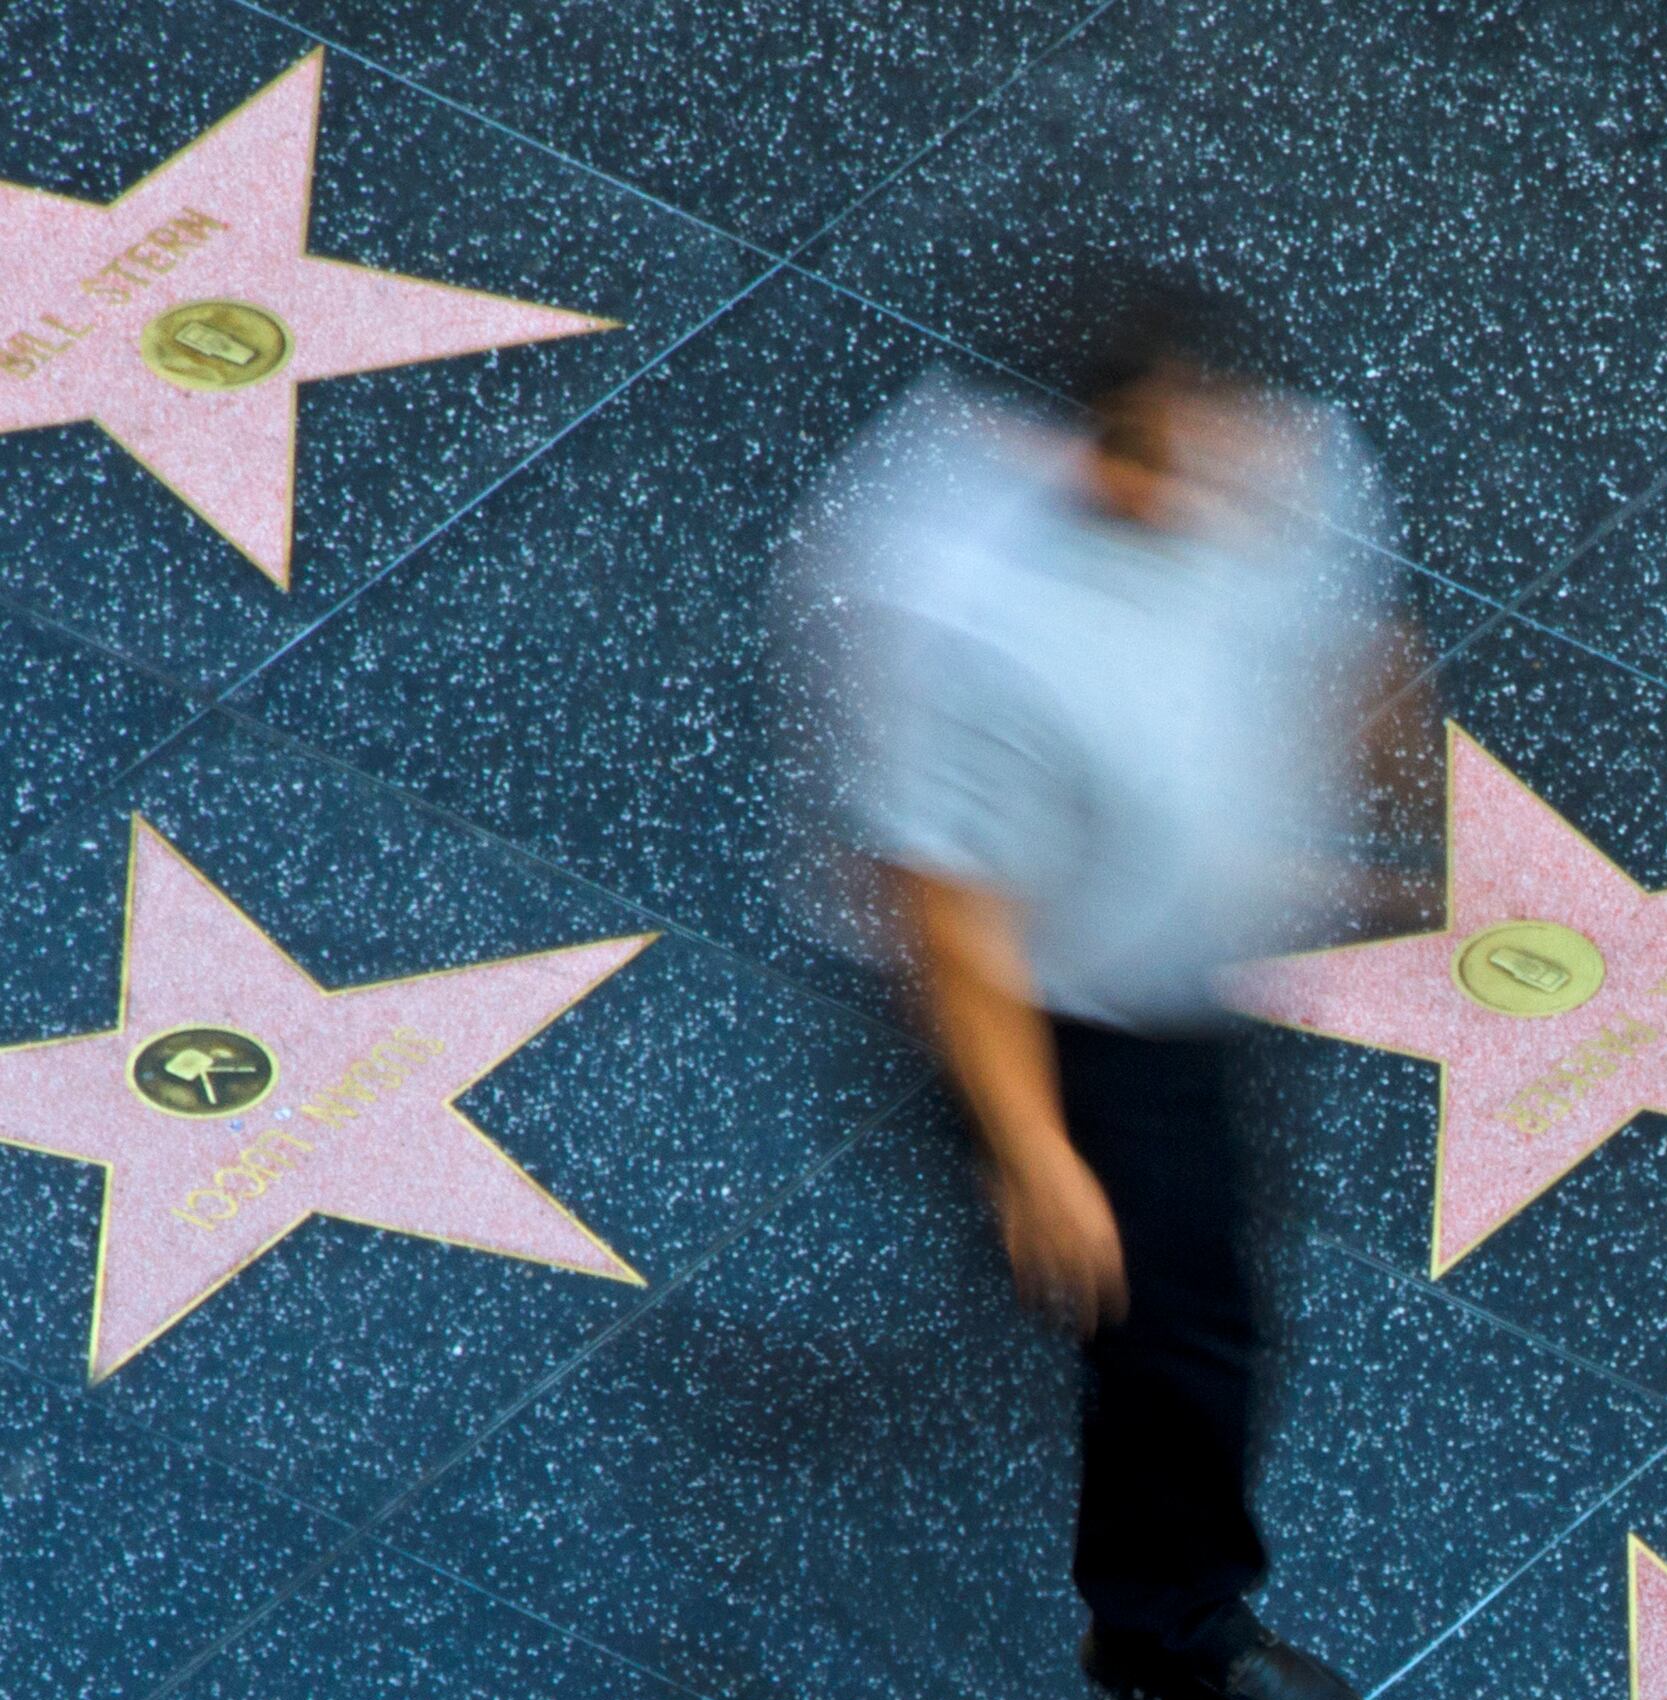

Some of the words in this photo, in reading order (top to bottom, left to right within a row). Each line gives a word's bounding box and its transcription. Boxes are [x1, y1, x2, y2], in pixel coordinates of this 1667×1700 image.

[0, 312, 97, 380] BILL
[80, 206, 230, 306] STERN
[300, 1026, 446, 1131] SUSAN
[1494, 1010, 1660, 1136] PARKER
[170, 1129, 315, 1231] LUCCI
